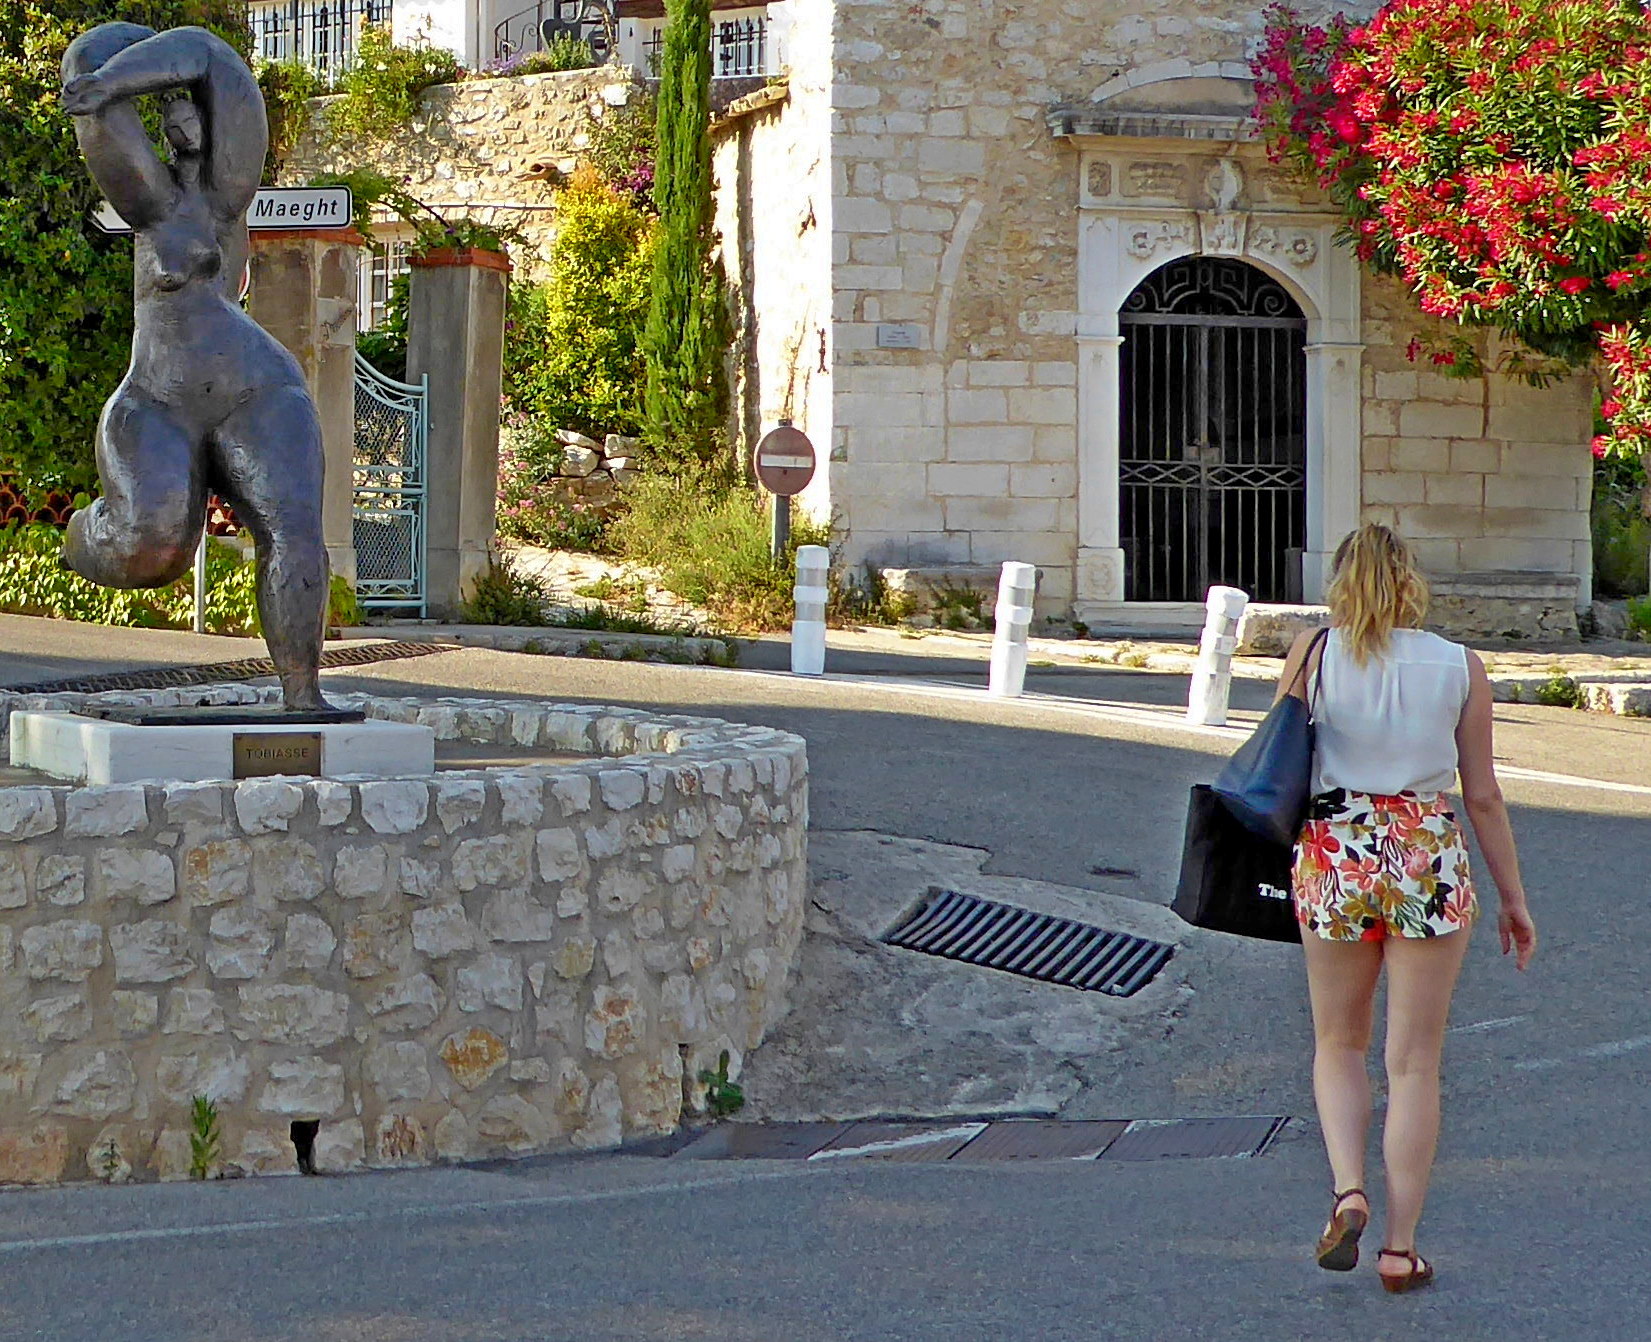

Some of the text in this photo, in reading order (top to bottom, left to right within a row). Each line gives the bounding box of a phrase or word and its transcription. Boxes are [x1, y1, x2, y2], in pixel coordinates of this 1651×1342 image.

[255, 198, 338, 221] Maeght
[246, 747, 309, 760] TOBIASSE
[1258, 883, 1287, 900] The
